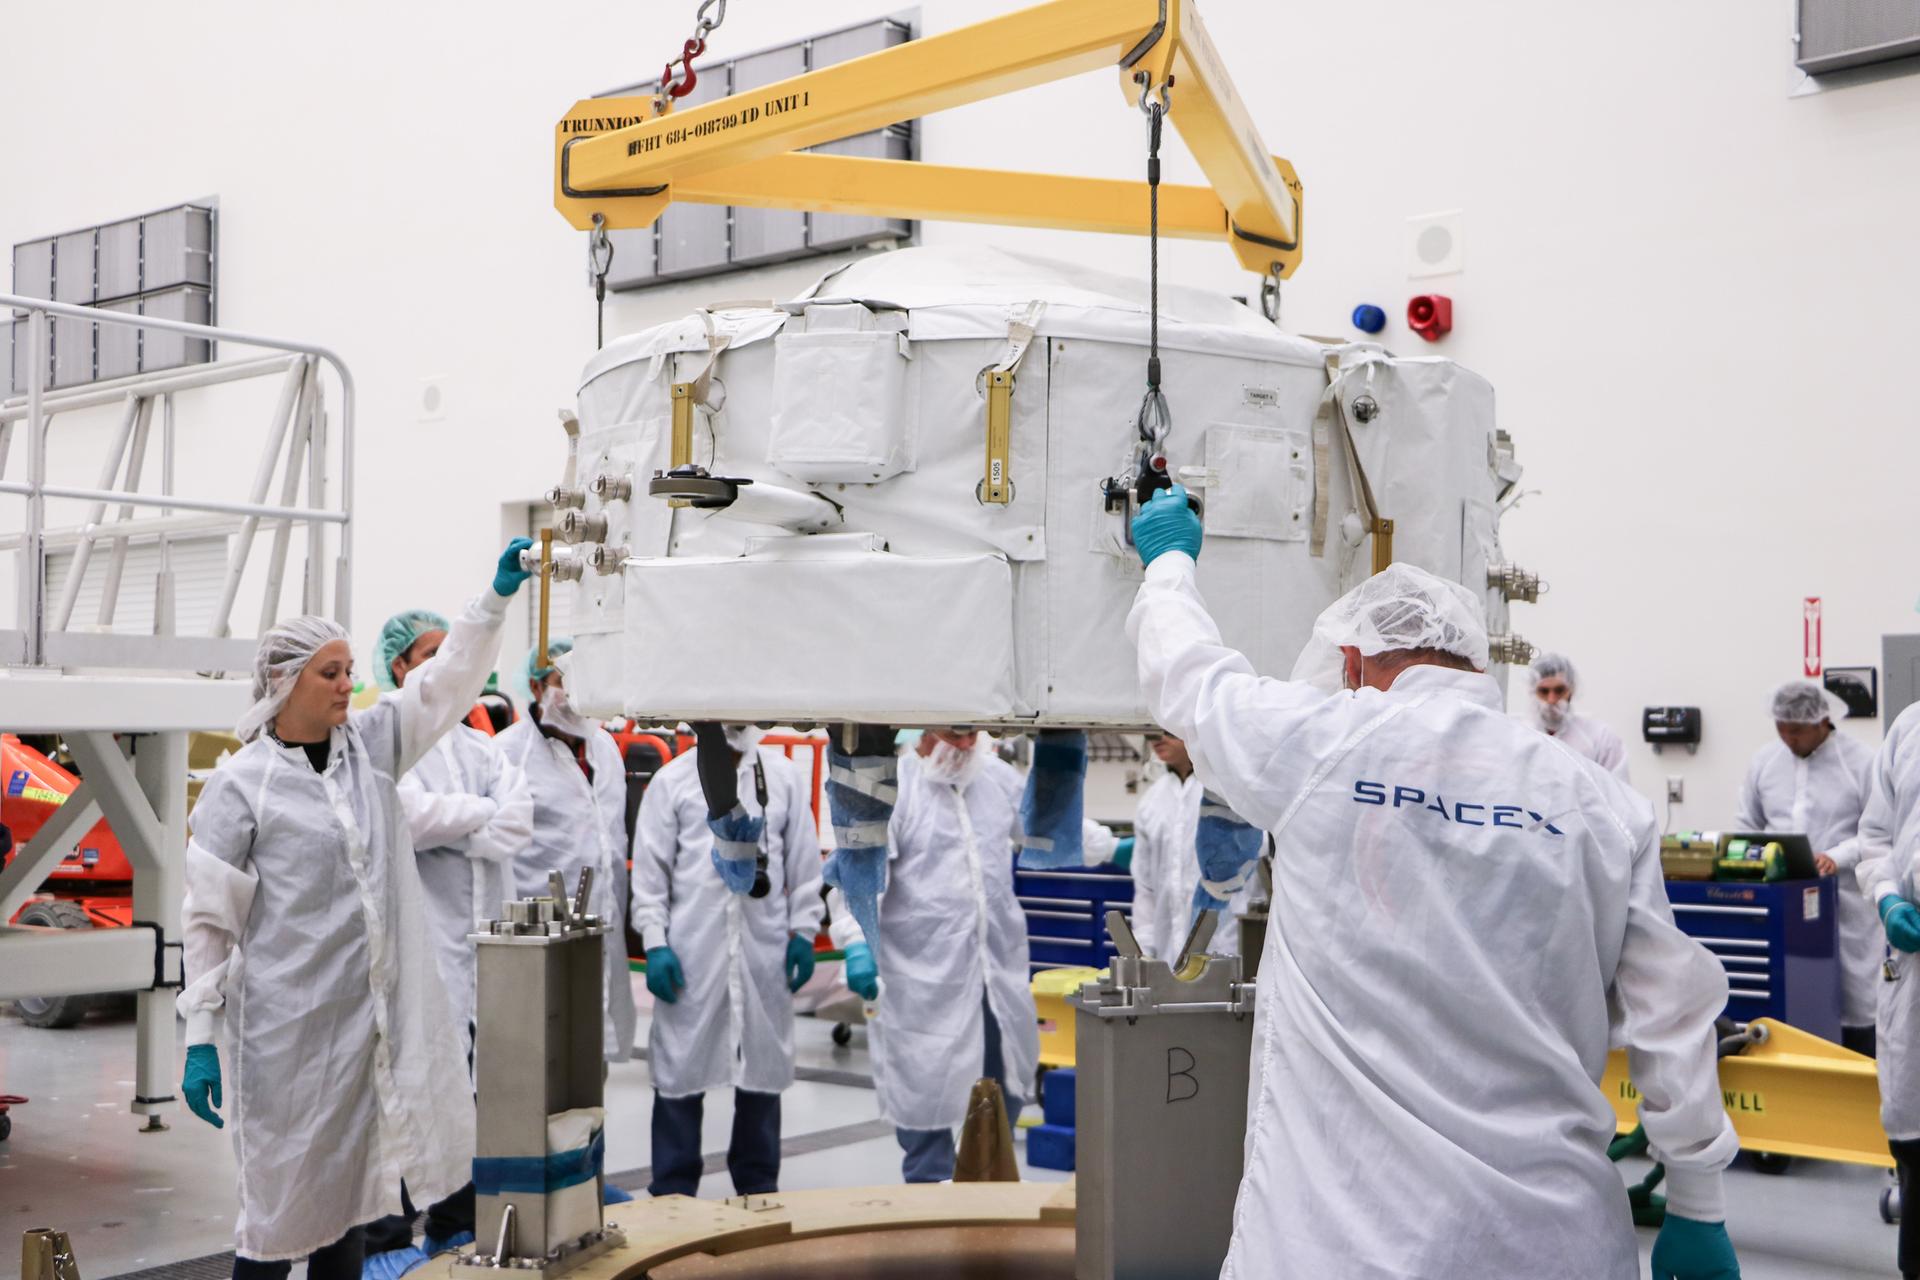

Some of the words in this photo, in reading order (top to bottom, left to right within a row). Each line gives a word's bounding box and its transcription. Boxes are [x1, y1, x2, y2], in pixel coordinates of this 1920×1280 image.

[666, 113, 738, 145] 684-018799
[741, 107, 760, 125] TD
[765, 94, 799, 117] UNIT
[993, 461, 1001, 482] 1505
[1353, 780, 1565, 835] SPACEX
[1166, 1046, 1199, 1104] B
[1724, 1090, 1763, 1112] WLL
